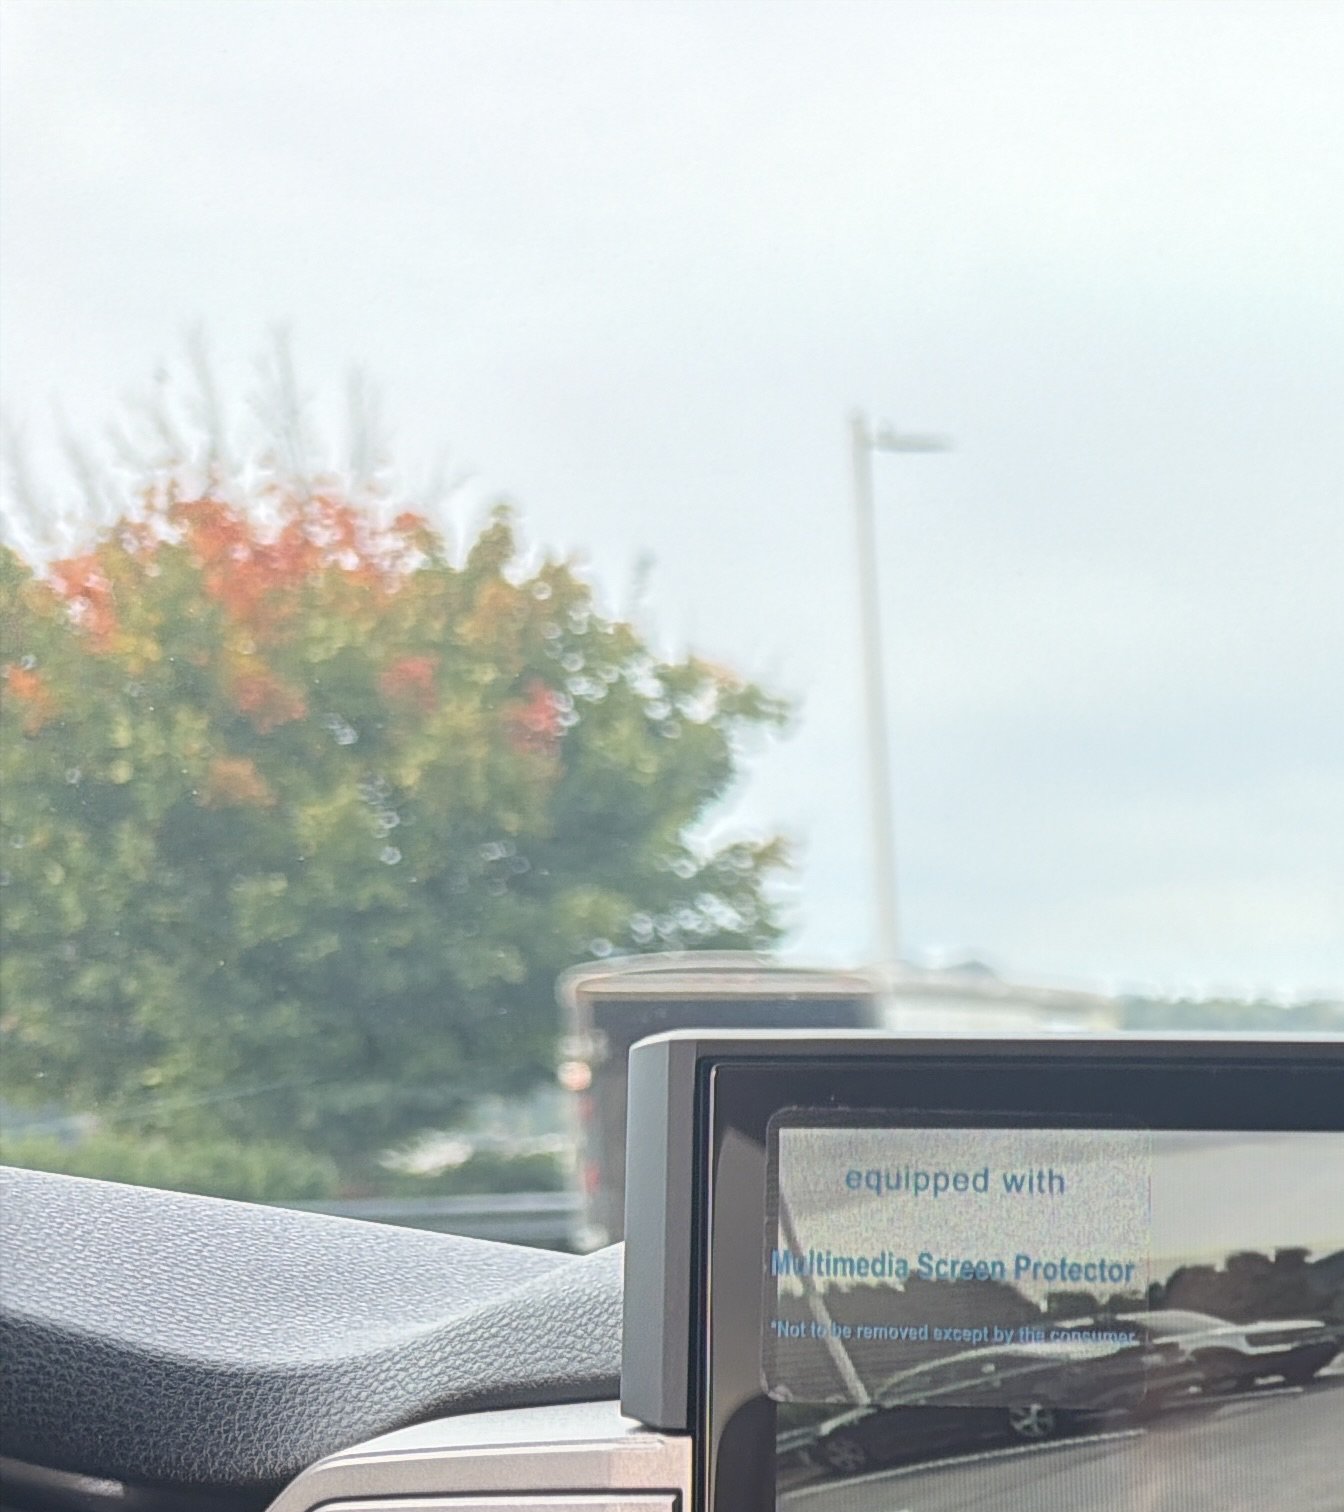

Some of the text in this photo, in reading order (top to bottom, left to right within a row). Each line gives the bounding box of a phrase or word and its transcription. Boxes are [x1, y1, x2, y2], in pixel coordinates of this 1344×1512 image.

[845, 1165, 1066, 1198] equipped with
[771, 1249, 1135, 1283] Multimedia Screen Protector
[811, 1320, 828, 1338] to
[832, 1319, 851, 1339] be
[857, 1323, 929, 1341] removed
[934, 1327, 988, 1344] except
[993, 1325, 1014, 1344] by
[1019, 1327, 1045, 1343] the
